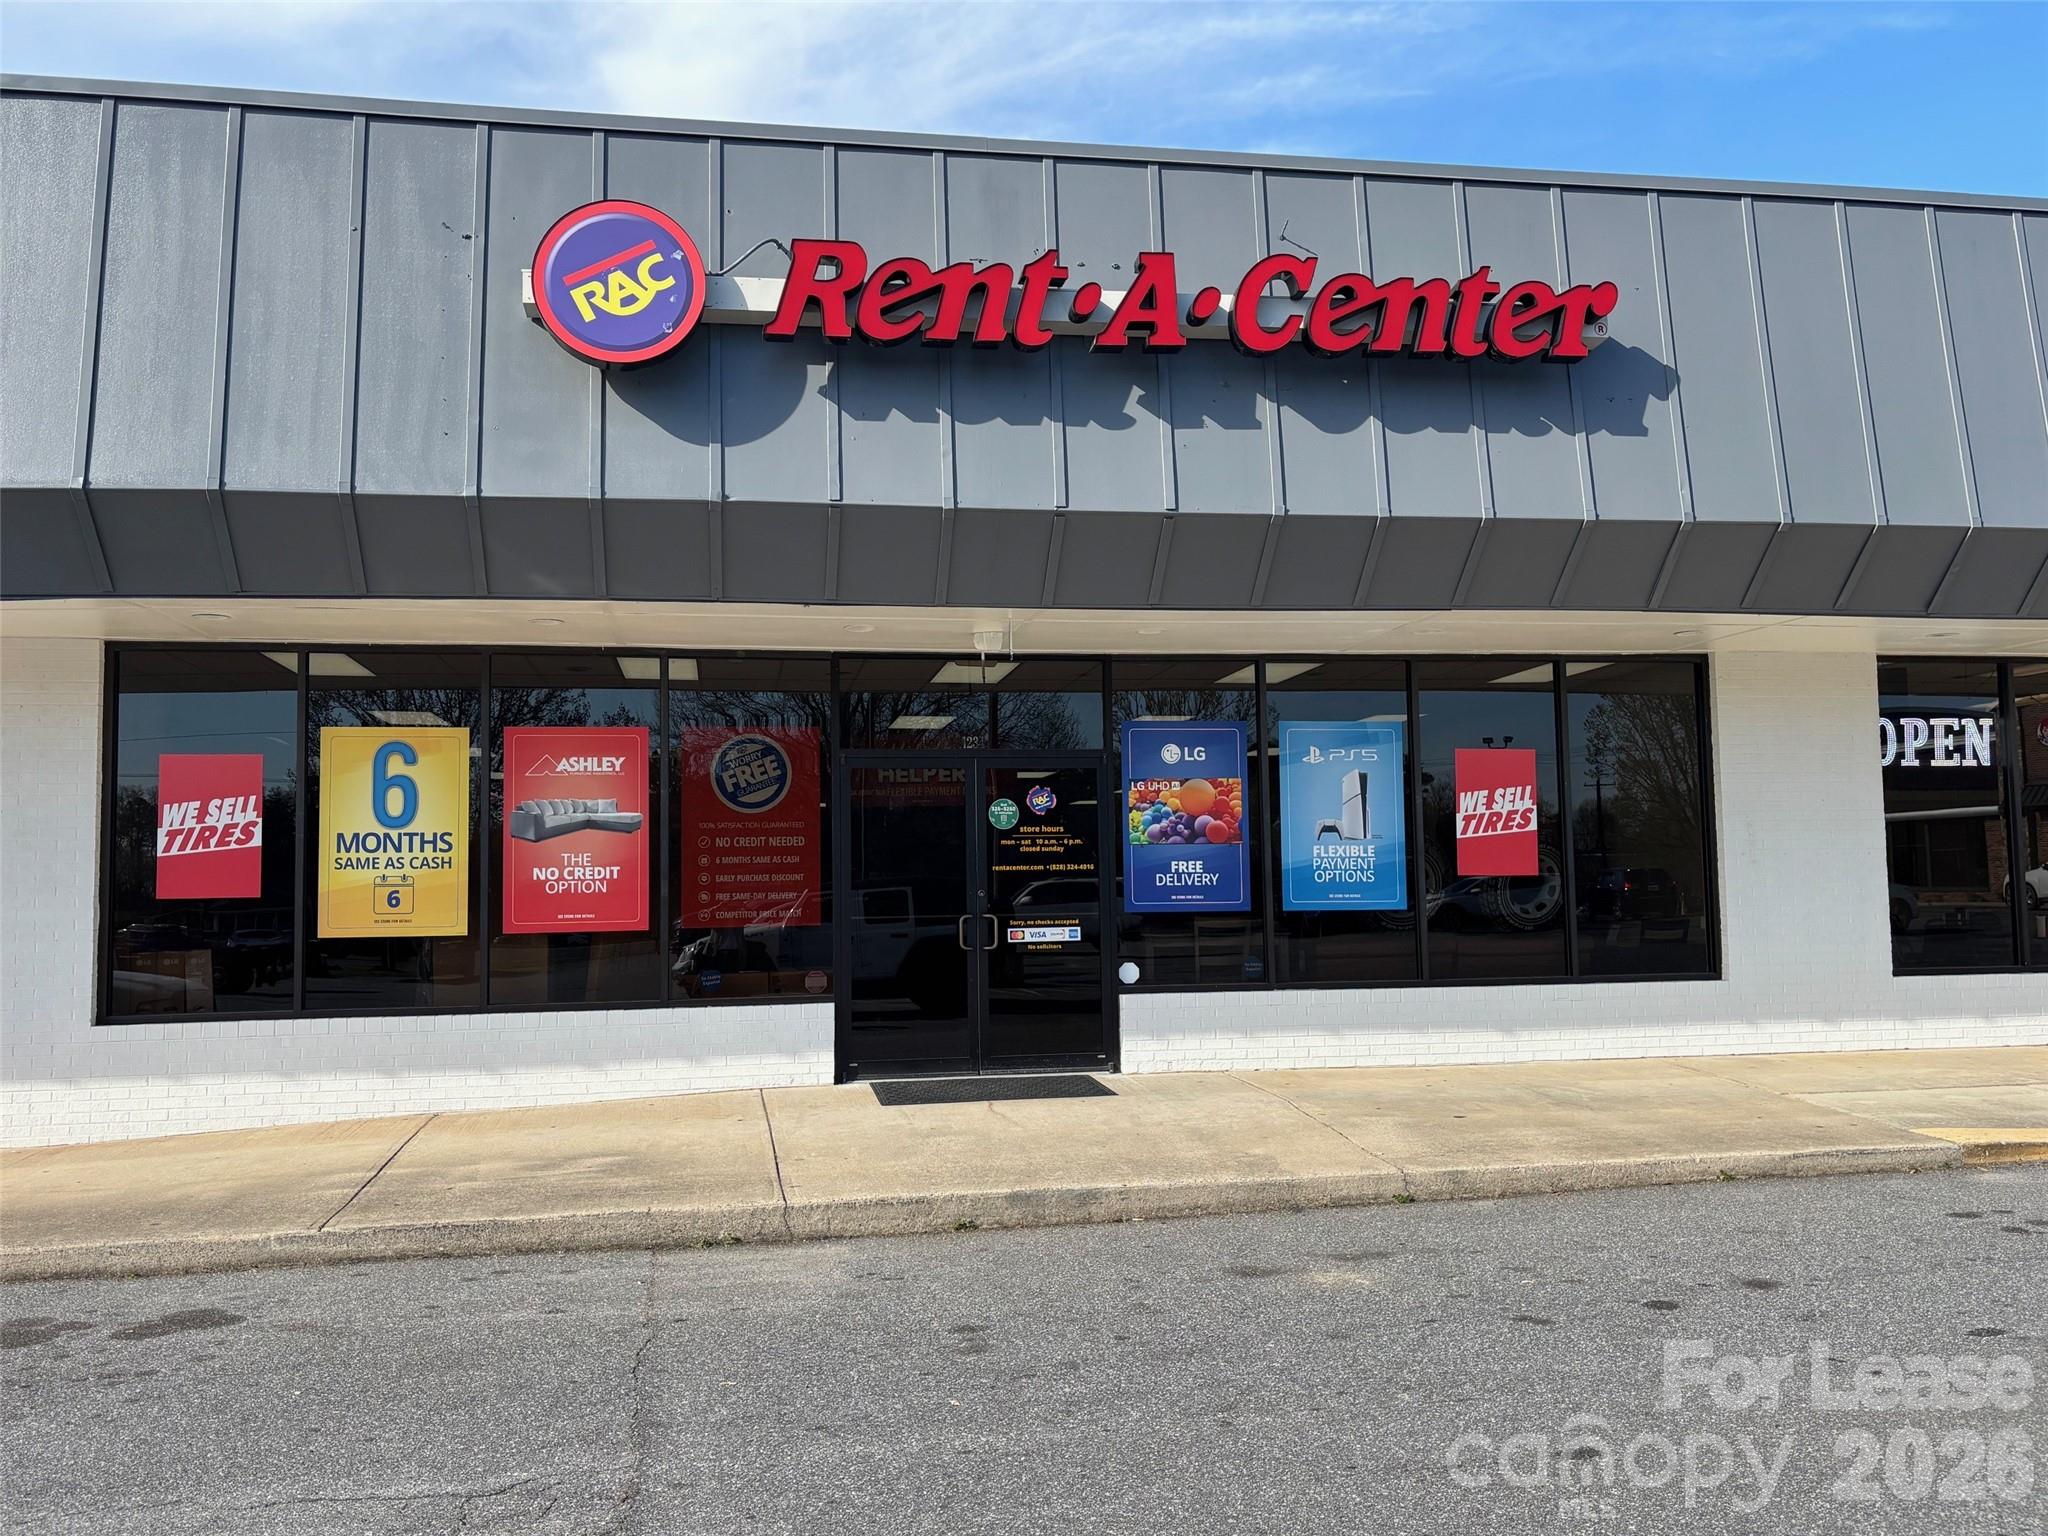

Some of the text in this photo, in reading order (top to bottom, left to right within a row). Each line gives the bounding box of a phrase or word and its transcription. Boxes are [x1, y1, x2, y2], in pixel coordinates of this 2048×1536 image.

[569, 253, 676, 323] RAC
[1879, 717, 1994, 767] OPEN
[729, 750, 764, 769] WORRY
[1184, 747, 1206, 761] LG
[1329, 749, 1379, 761] PS5
[555, 756, 627, 773] ASHLEY
[720, 754, 783, 793] FREE
[877, 768, 966, 783] HELPER
[371, 739, 420, 831] 6
[925, 785, 961, 797] PAYMENT
[1130, 781, 1145, 791] LG
[1147, 781, 1170, 791] UHD
[1032, 793, 1050, 806] RAC
[1459, 785, 1534, 814] WE SELL
[162, 795, 259, 828] WE SELL
[716, 822, 760, 830] SATISFACTION
[761, 821, 805, 829] GUARANTEED
[1459, 807, 1536, 836] TIRES
[1019, 825, 1064, 833] store hours
[161, 820, 261, 854] TIRES
[335, 831, 454, 854] MONTHS
[715, 835, 806, 848] NO CREDIT NEEDED
[1041, 845, 1065, 853] sunday
[1312, 845, 1376, 858] FLEXIBLE
[334, 856, 453, 870] SAME AS CASH
[560, 853, 592, 867] THE
[722, 855, 751, 865] MONTHS
[752, 855, 771, 864] SAME
[771, 855, 782, 864] AS
[782, 854, 800, 864] CASH
[1312, 857, 1377, 870] PAYMENT
[1170, 860, 1204, 873] FREE
[532, 866, 621, 881] NO CREDIT
[715, 873, 805, 883] EARLY PURCHASE DISCOUNT
[1155, 873, 1220, 886] DELIVERY
[1314, 870, 1376, 883] OPTIONS
[544, 880, 608, 895] OPTION
[386, 889, 401, 909] 6
[715, 891, 798, 901] FREE SAME-DAY DELIVERY
[715, 910, 758, 920] COMPETITOR
[1054, 918, 1079, 926] accepted
[1029, 931, 1047, 939] VISA
